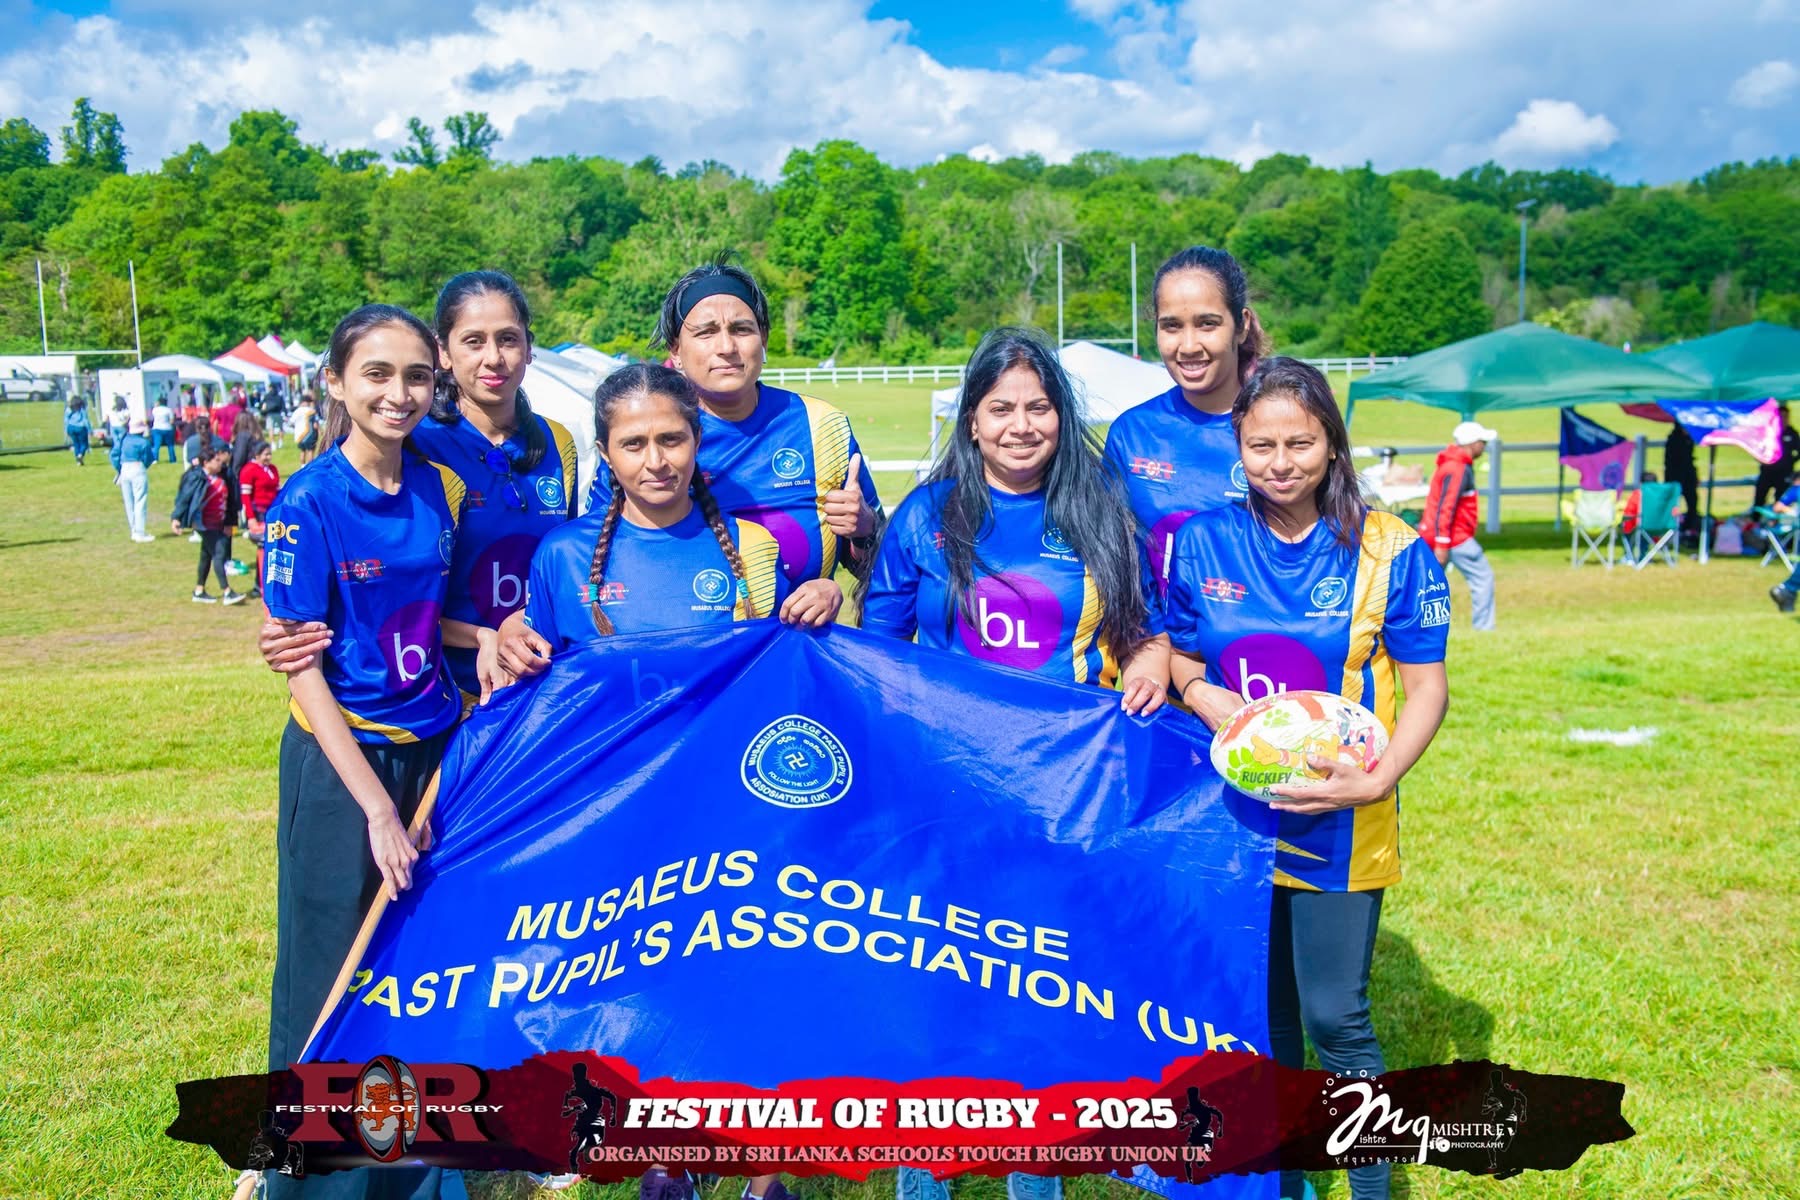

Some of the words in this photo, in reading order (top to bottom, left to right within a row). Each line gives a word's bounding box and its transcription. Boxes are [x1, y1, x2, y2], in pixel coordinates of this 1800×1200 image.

[777, 720, 822, 736] COLLEGE
[822, 735, 841, 757] PAST
[768, 771, 791, 785] FOLLOW
[791, 780, 803, 788] THE
[804, 779, 819, 787] LIGHT
[506, 849, 758, 942] MUSAEUS
[776, 864, 1070, 961] COLLEGE
[488, 921, 674, 1009] PUPIL'S
[682, 905, 1115, 1021] ASSOCIATION
